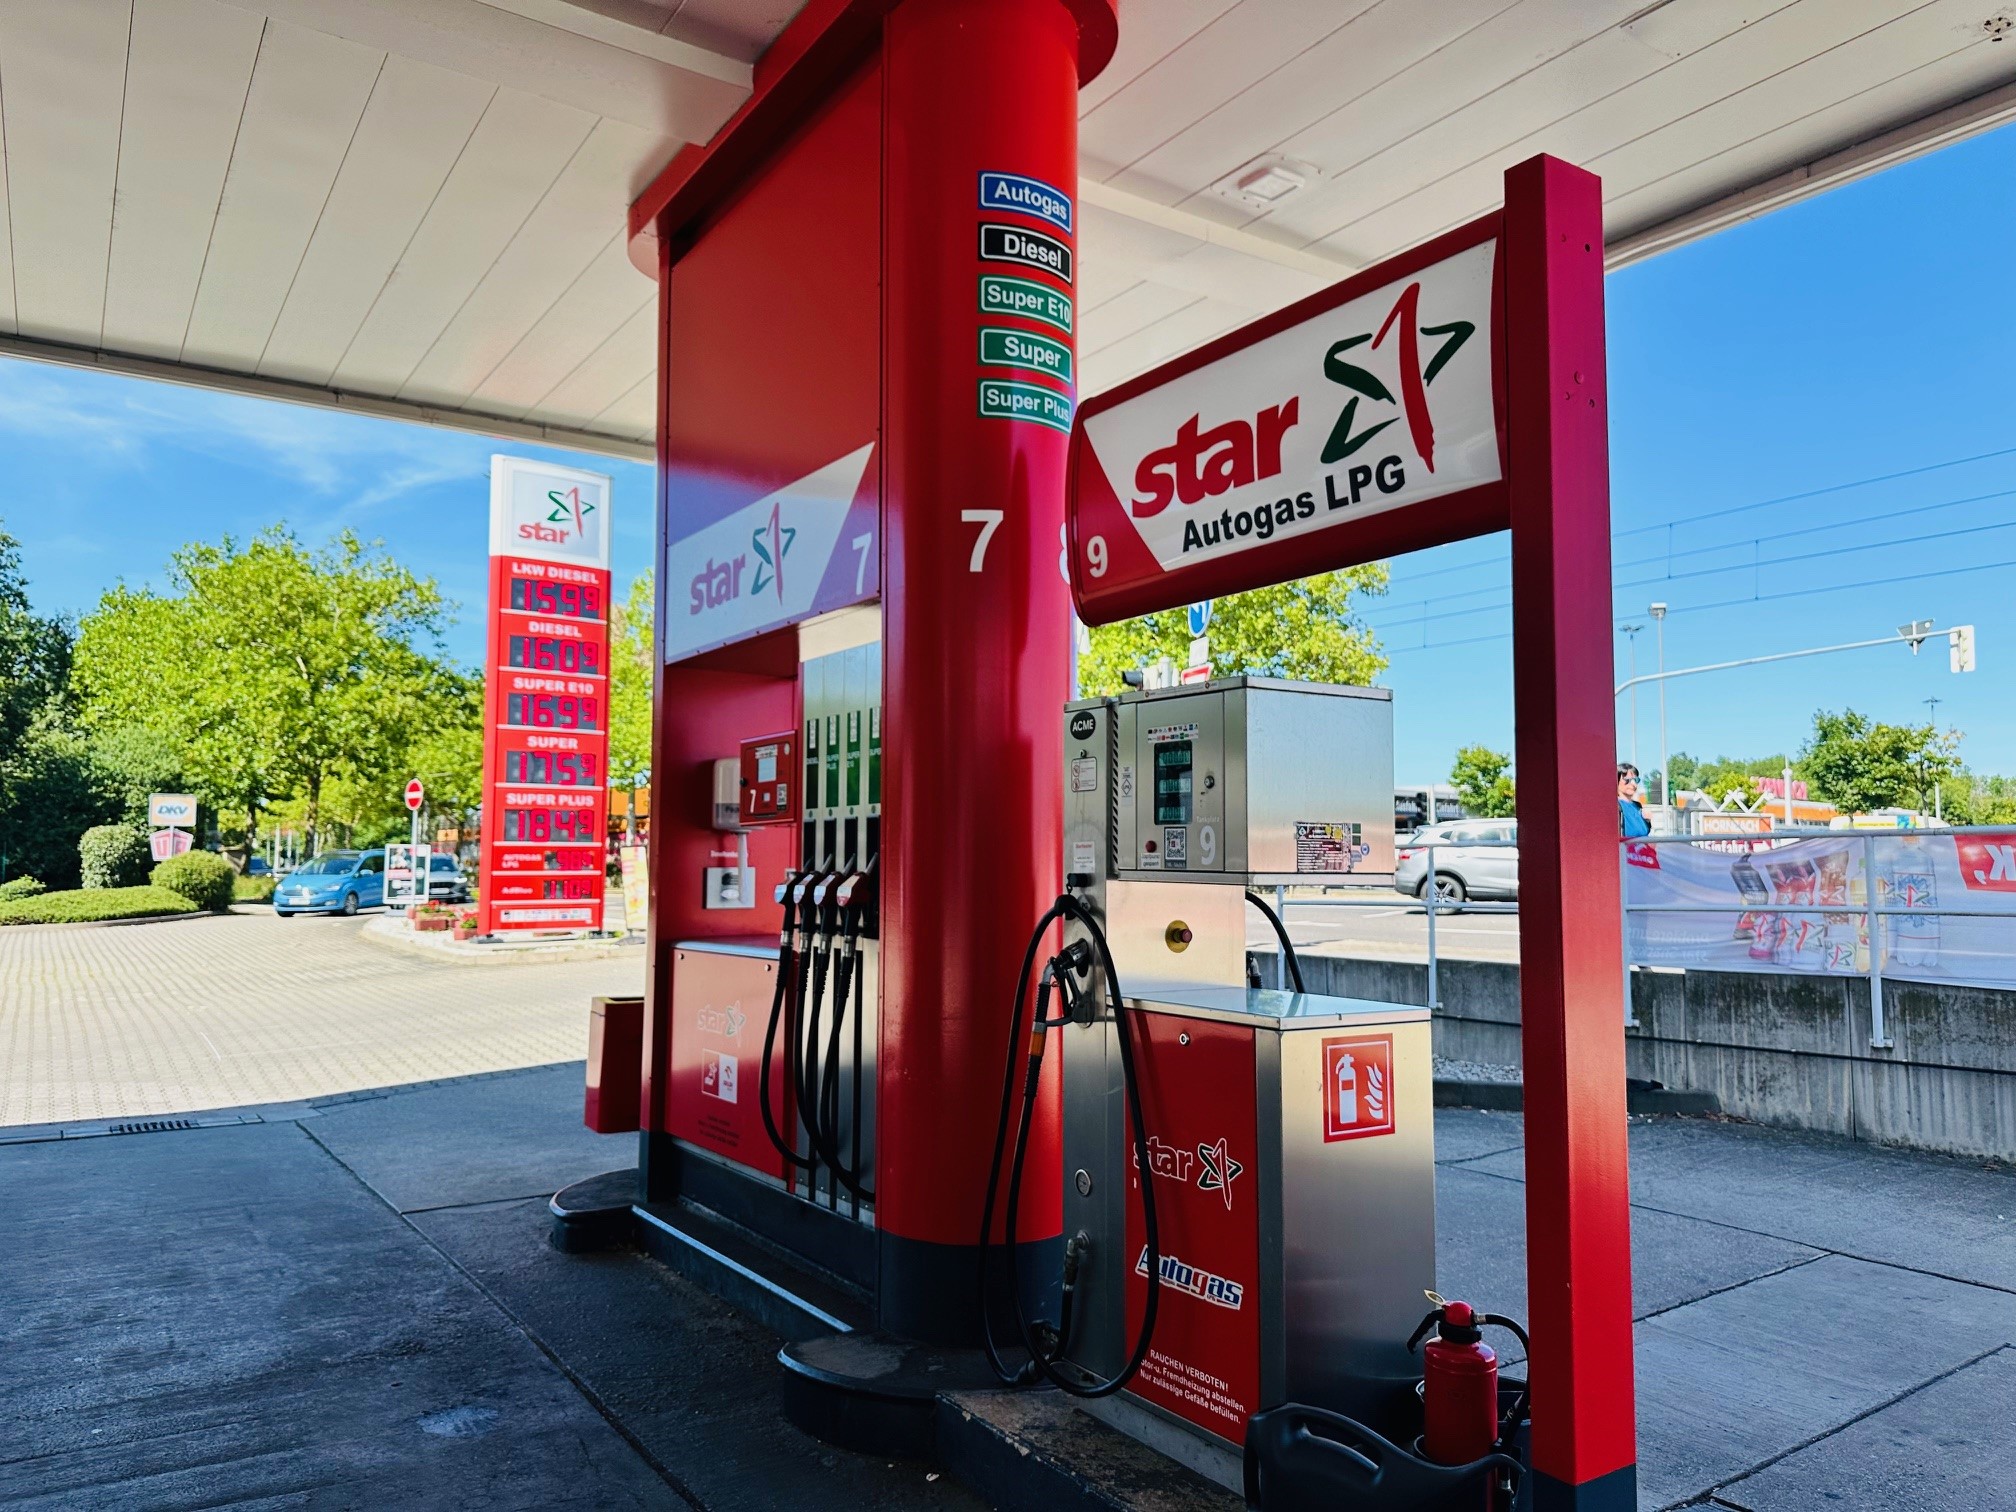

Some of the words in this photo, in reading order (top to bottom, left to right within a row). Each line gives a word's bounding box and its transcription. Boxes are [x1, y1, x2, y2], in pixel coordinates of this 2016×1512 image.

[994, 181, 1067, 220] Autogas
[1004, 233, 1061, 270] Diesel
[987, 284, 1045, 310] Super
[1047, 296, 1071, 324] E10
[1004, 336, 1061, 368] Super
[986, 388, 1041, 412] Super
[1043, 396, 1069, 423] Plus
[1131, 396, 1299, 518] star
[1182, 491, 1316, 553] Autogas
[1325, 455, 1406, 510] LPG
[518, 521, 570, 544] star
[961, 509, 1004, 573] 7
[511, 562, 545, 577] LKW
[547, 565, 600, 584] DIESEL
[852, 531, 872, 596] 7
[1086, 535, 1108, 578] 9
[689, 553, 746, 615] star
[528, 621, 583, 637] DIESEL
[513, 677, 565, 693] SUPER
[568, 681, 595, 695] E10
[527, 735, 578, 749] SUPER
[1072, 718, 1094, 732] ACME
[157, 804, 189, 815] DKV
[505, 793, 556, 806] SUPER
[558, 794, 595, 807] PLUS
[1200, 824, 1216, 866] 9
[1150, 1349, 1184, 1372] RAUCHEN
[1185, 1365, 1229, 1392] VERBOTEN!
[1140, 1368, 1152, 1381] Nur
[1152, 1376, 1183, 1397] zulässige
[1184, 1390, 1209, 1409] Gefäße
[1210, 1402, 1241, 1424] befüllen.
[1162, 1367, 1211, 1399] Fremdheizung
[1211, 1391, 1246, 1414] abstellen.
